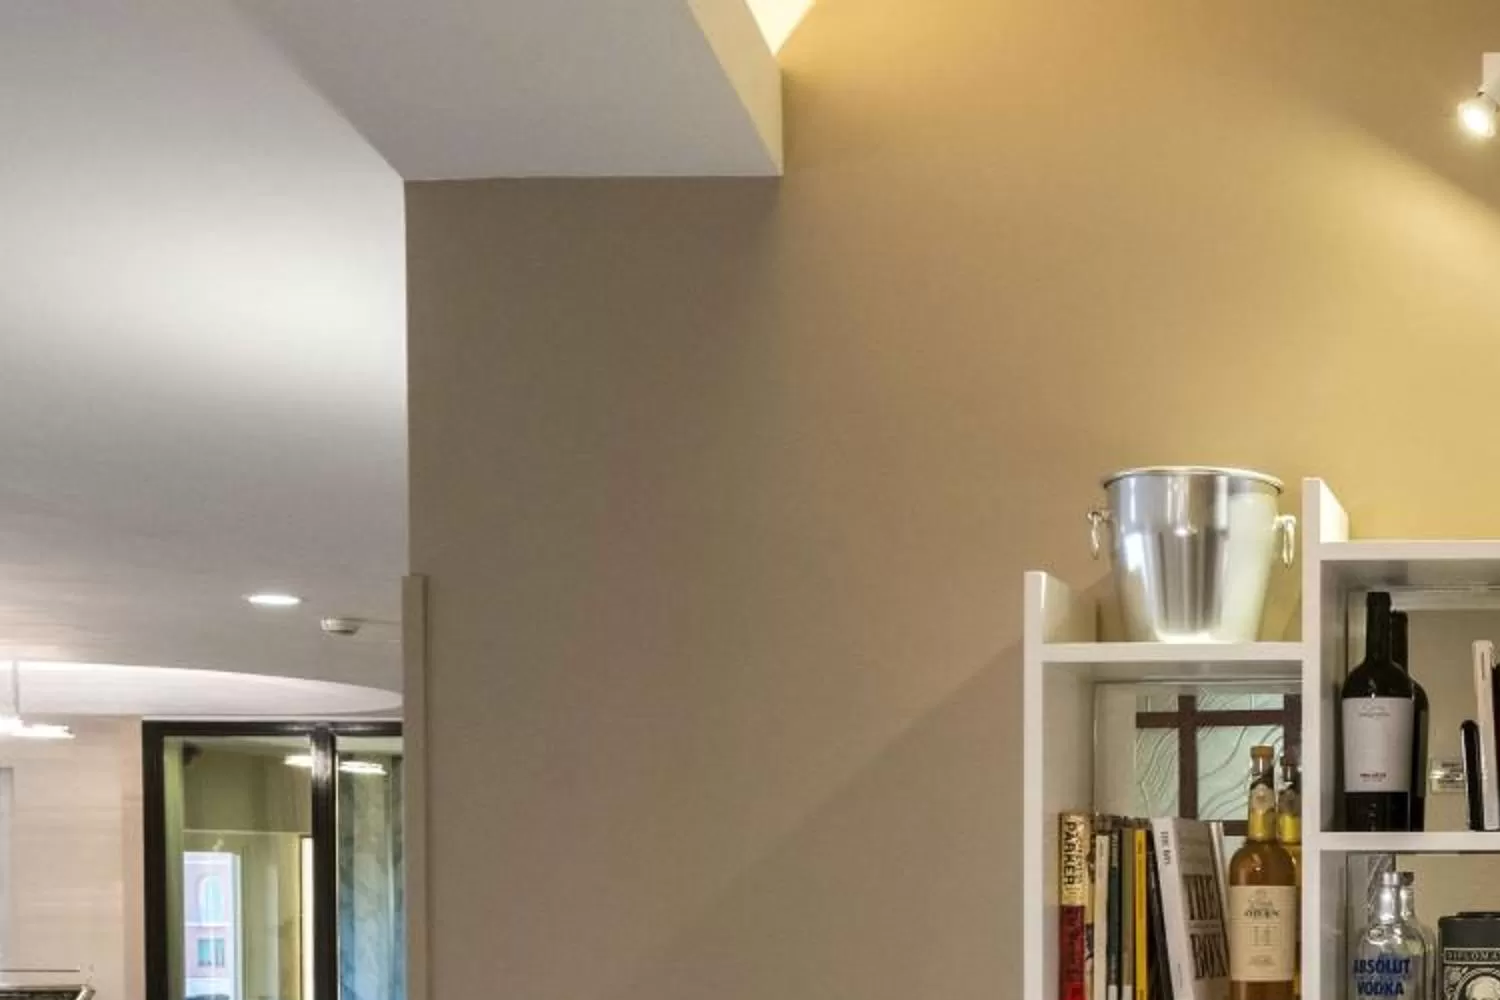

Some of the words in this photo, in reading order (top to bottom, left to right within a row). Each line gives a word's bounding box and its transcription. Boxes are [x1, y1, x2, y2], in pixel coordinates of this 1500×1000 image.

[1064, 821, 1077, 885] PARKER
[1352, 957, 1411, 975] ABSOLUT
[1357, 981, 1405, 996] VODKA
